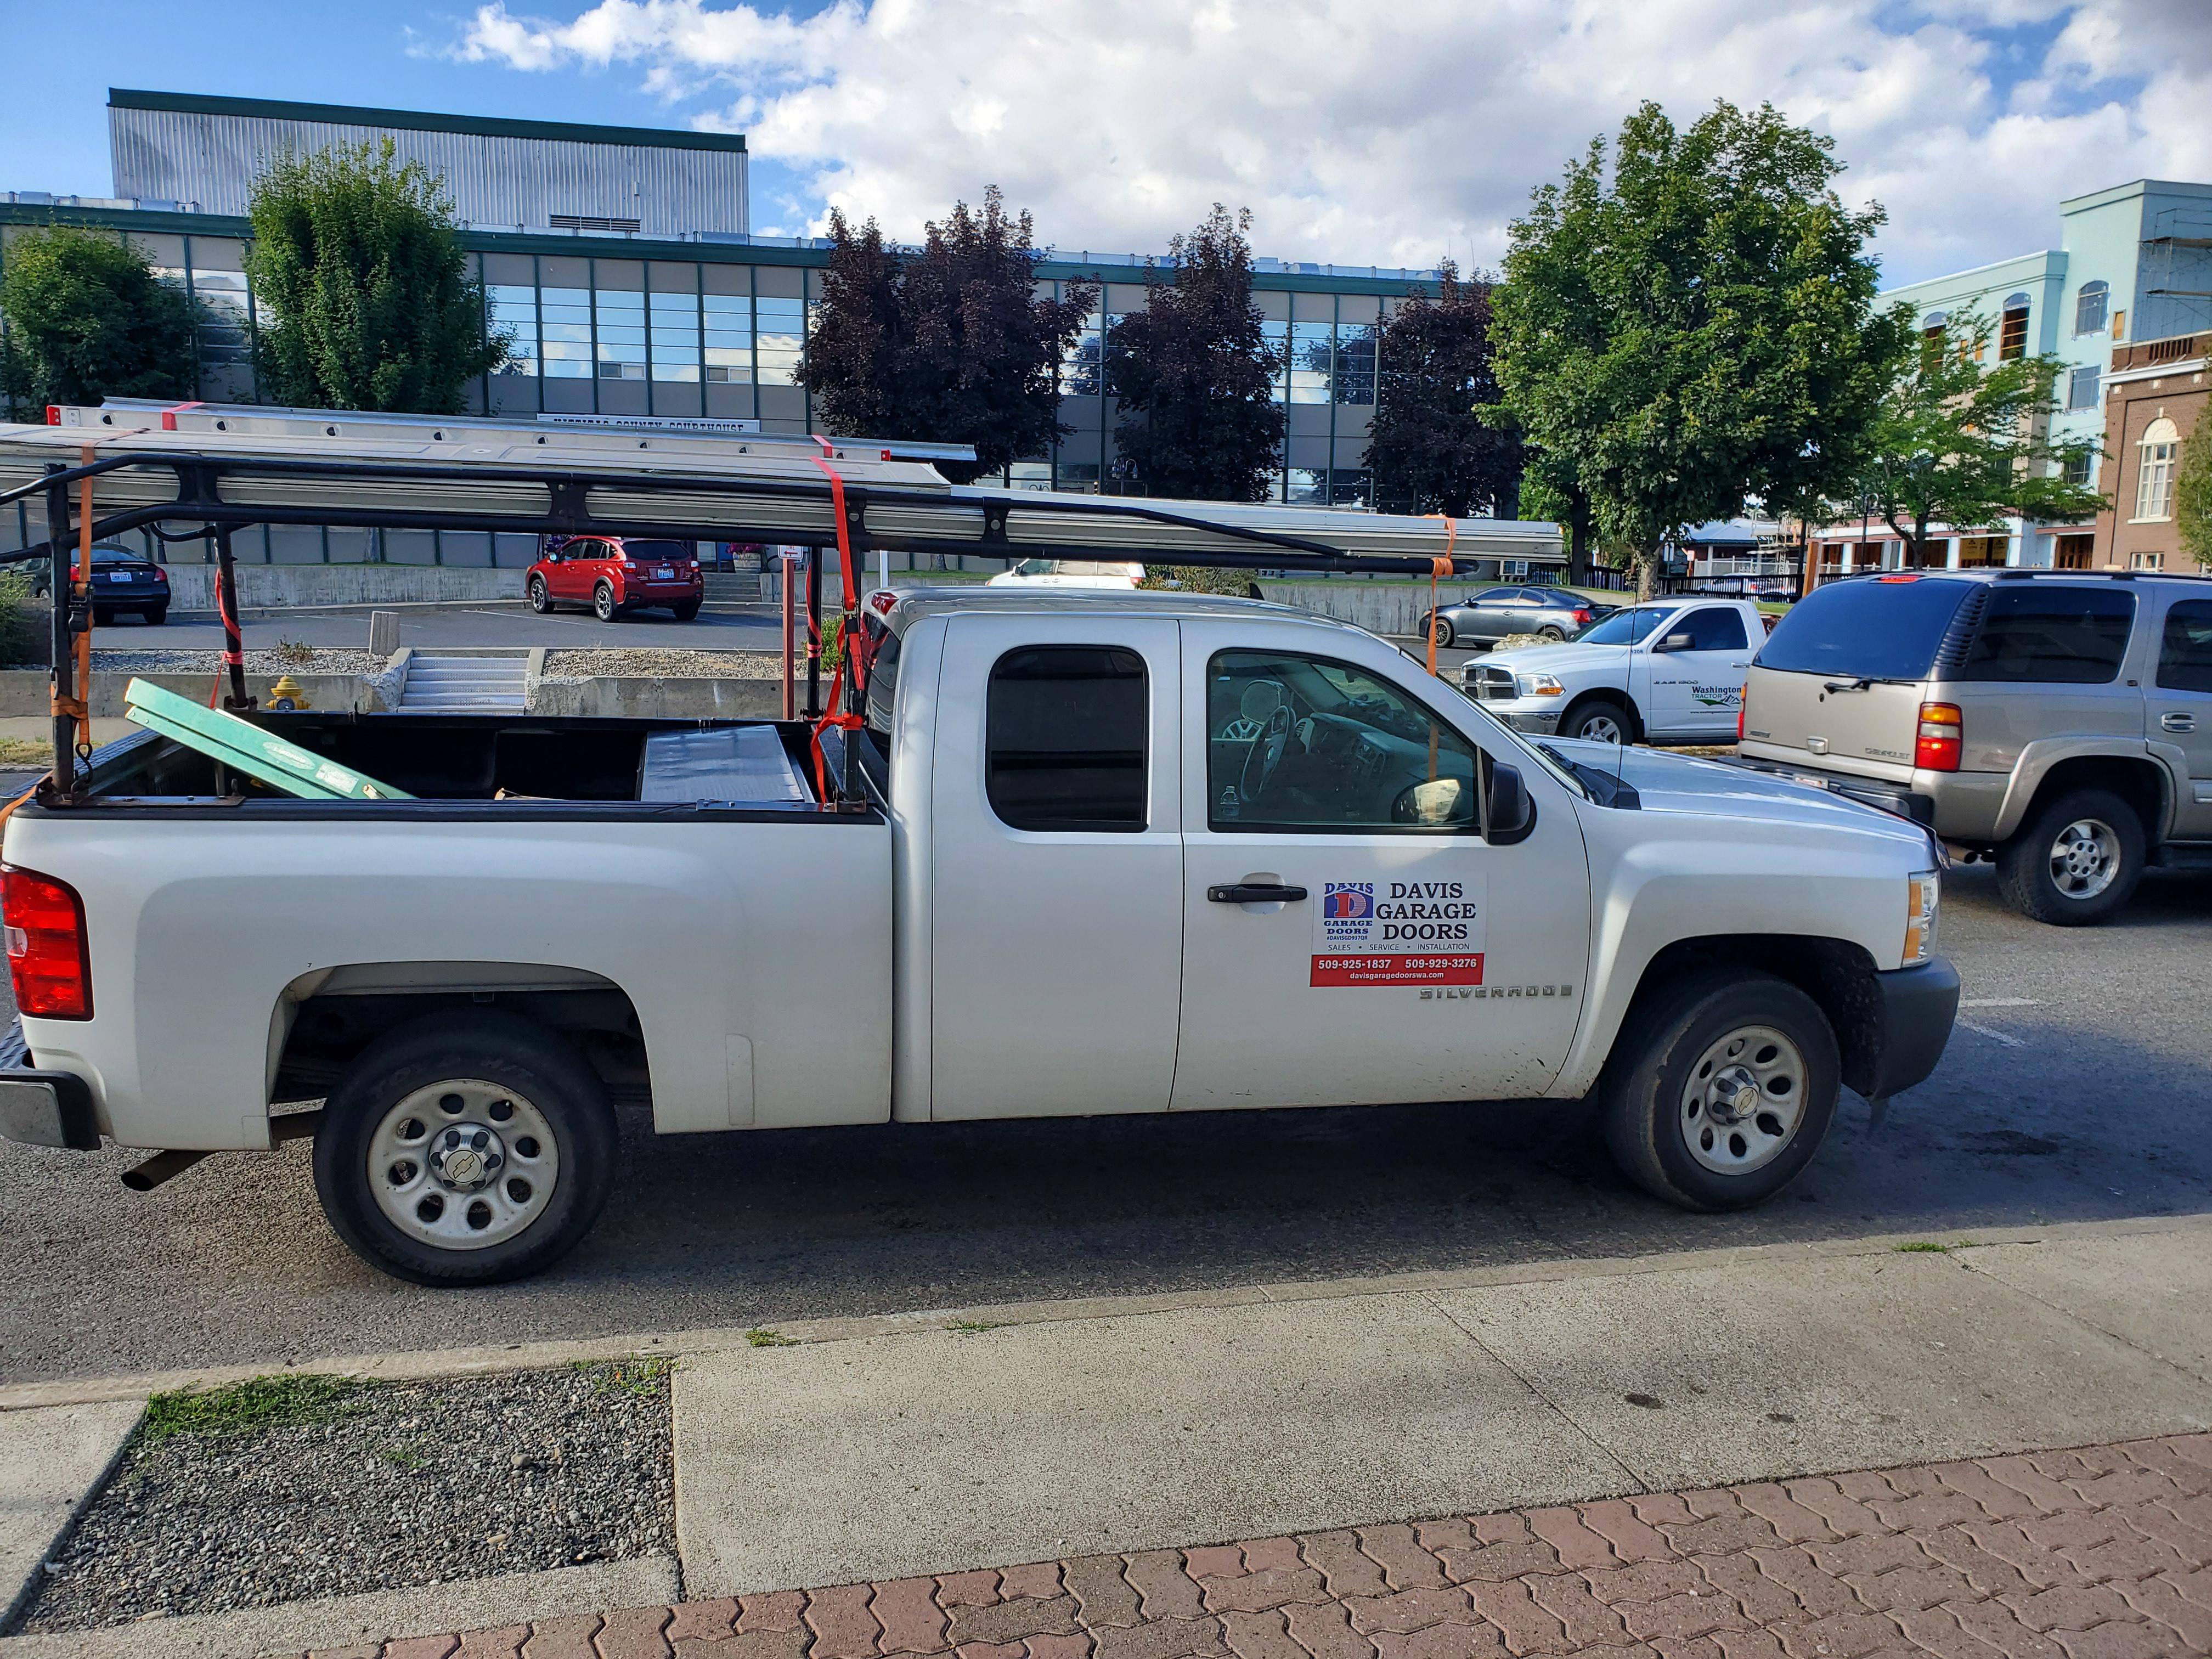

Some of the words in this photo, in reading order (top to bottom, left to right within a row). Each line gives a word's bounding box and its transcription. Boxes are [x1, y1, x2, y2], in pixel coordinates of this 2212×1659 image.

[1691, 686, 1742, 695] Washington
[1324, 882, 1374, 895] DAVIS
[1390, 882, 1464, 899] DAVIS
[1375, 903, 1477, 919] GARAGE
[1382, 923, 1468, 940] DOORS
[1318, 959, 1391, 969] 509-925-1837
[1404, 958, 1477, 969] 509-929-3276
[1350, 972, 1444, 980] davisgaragedoorswa.com
[1419, 986, 1555, 1000] SILVERADO
